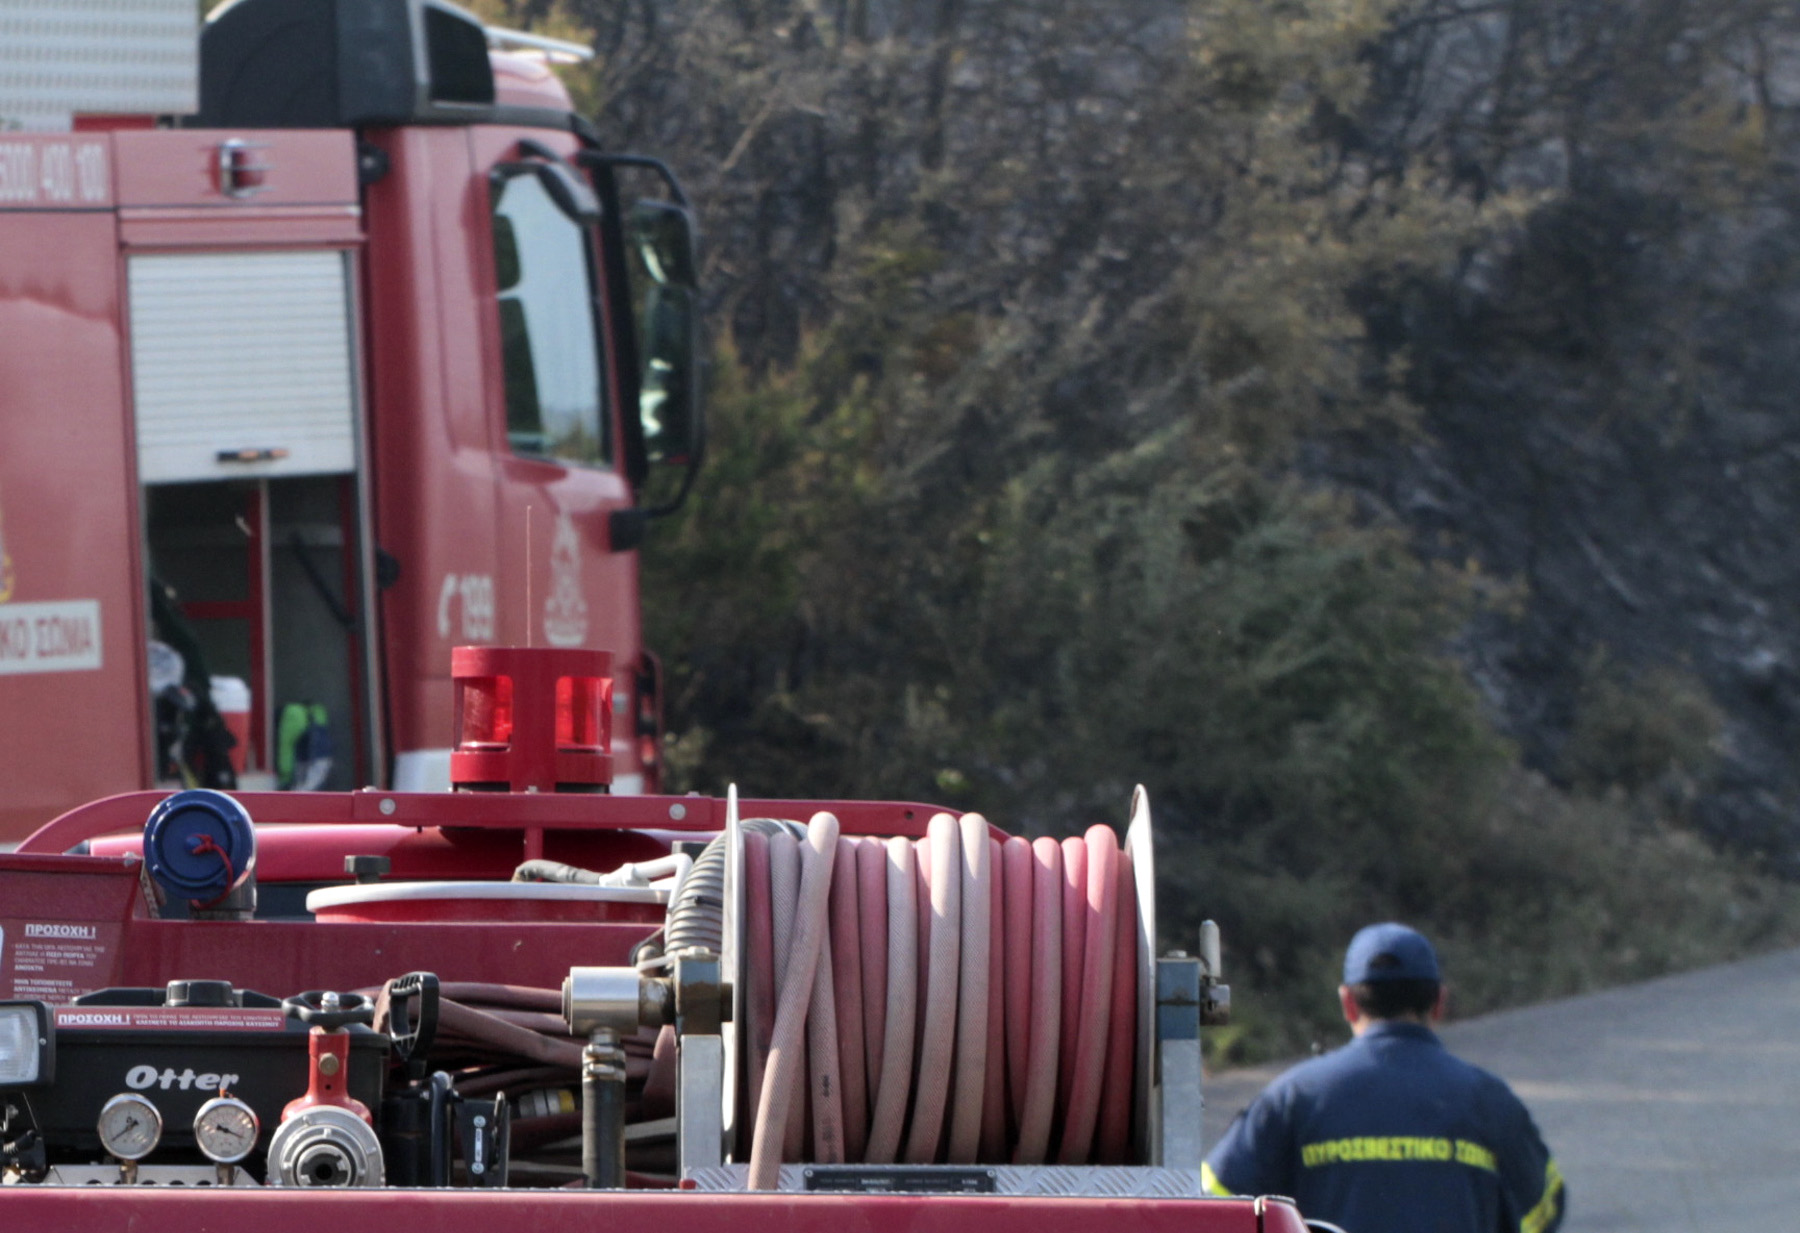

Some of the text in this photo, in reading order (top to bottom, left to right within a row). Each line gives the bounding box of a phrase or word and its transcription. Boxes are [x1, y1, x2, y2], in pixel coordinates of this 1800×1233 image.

[25, 923, 87, 938] ΠΡΟΣΟΧΗ
[58, 1013, 122, 1025] ΠΡΟΣΟΧΗ
[125, 1064, 240, 1091] Otter
